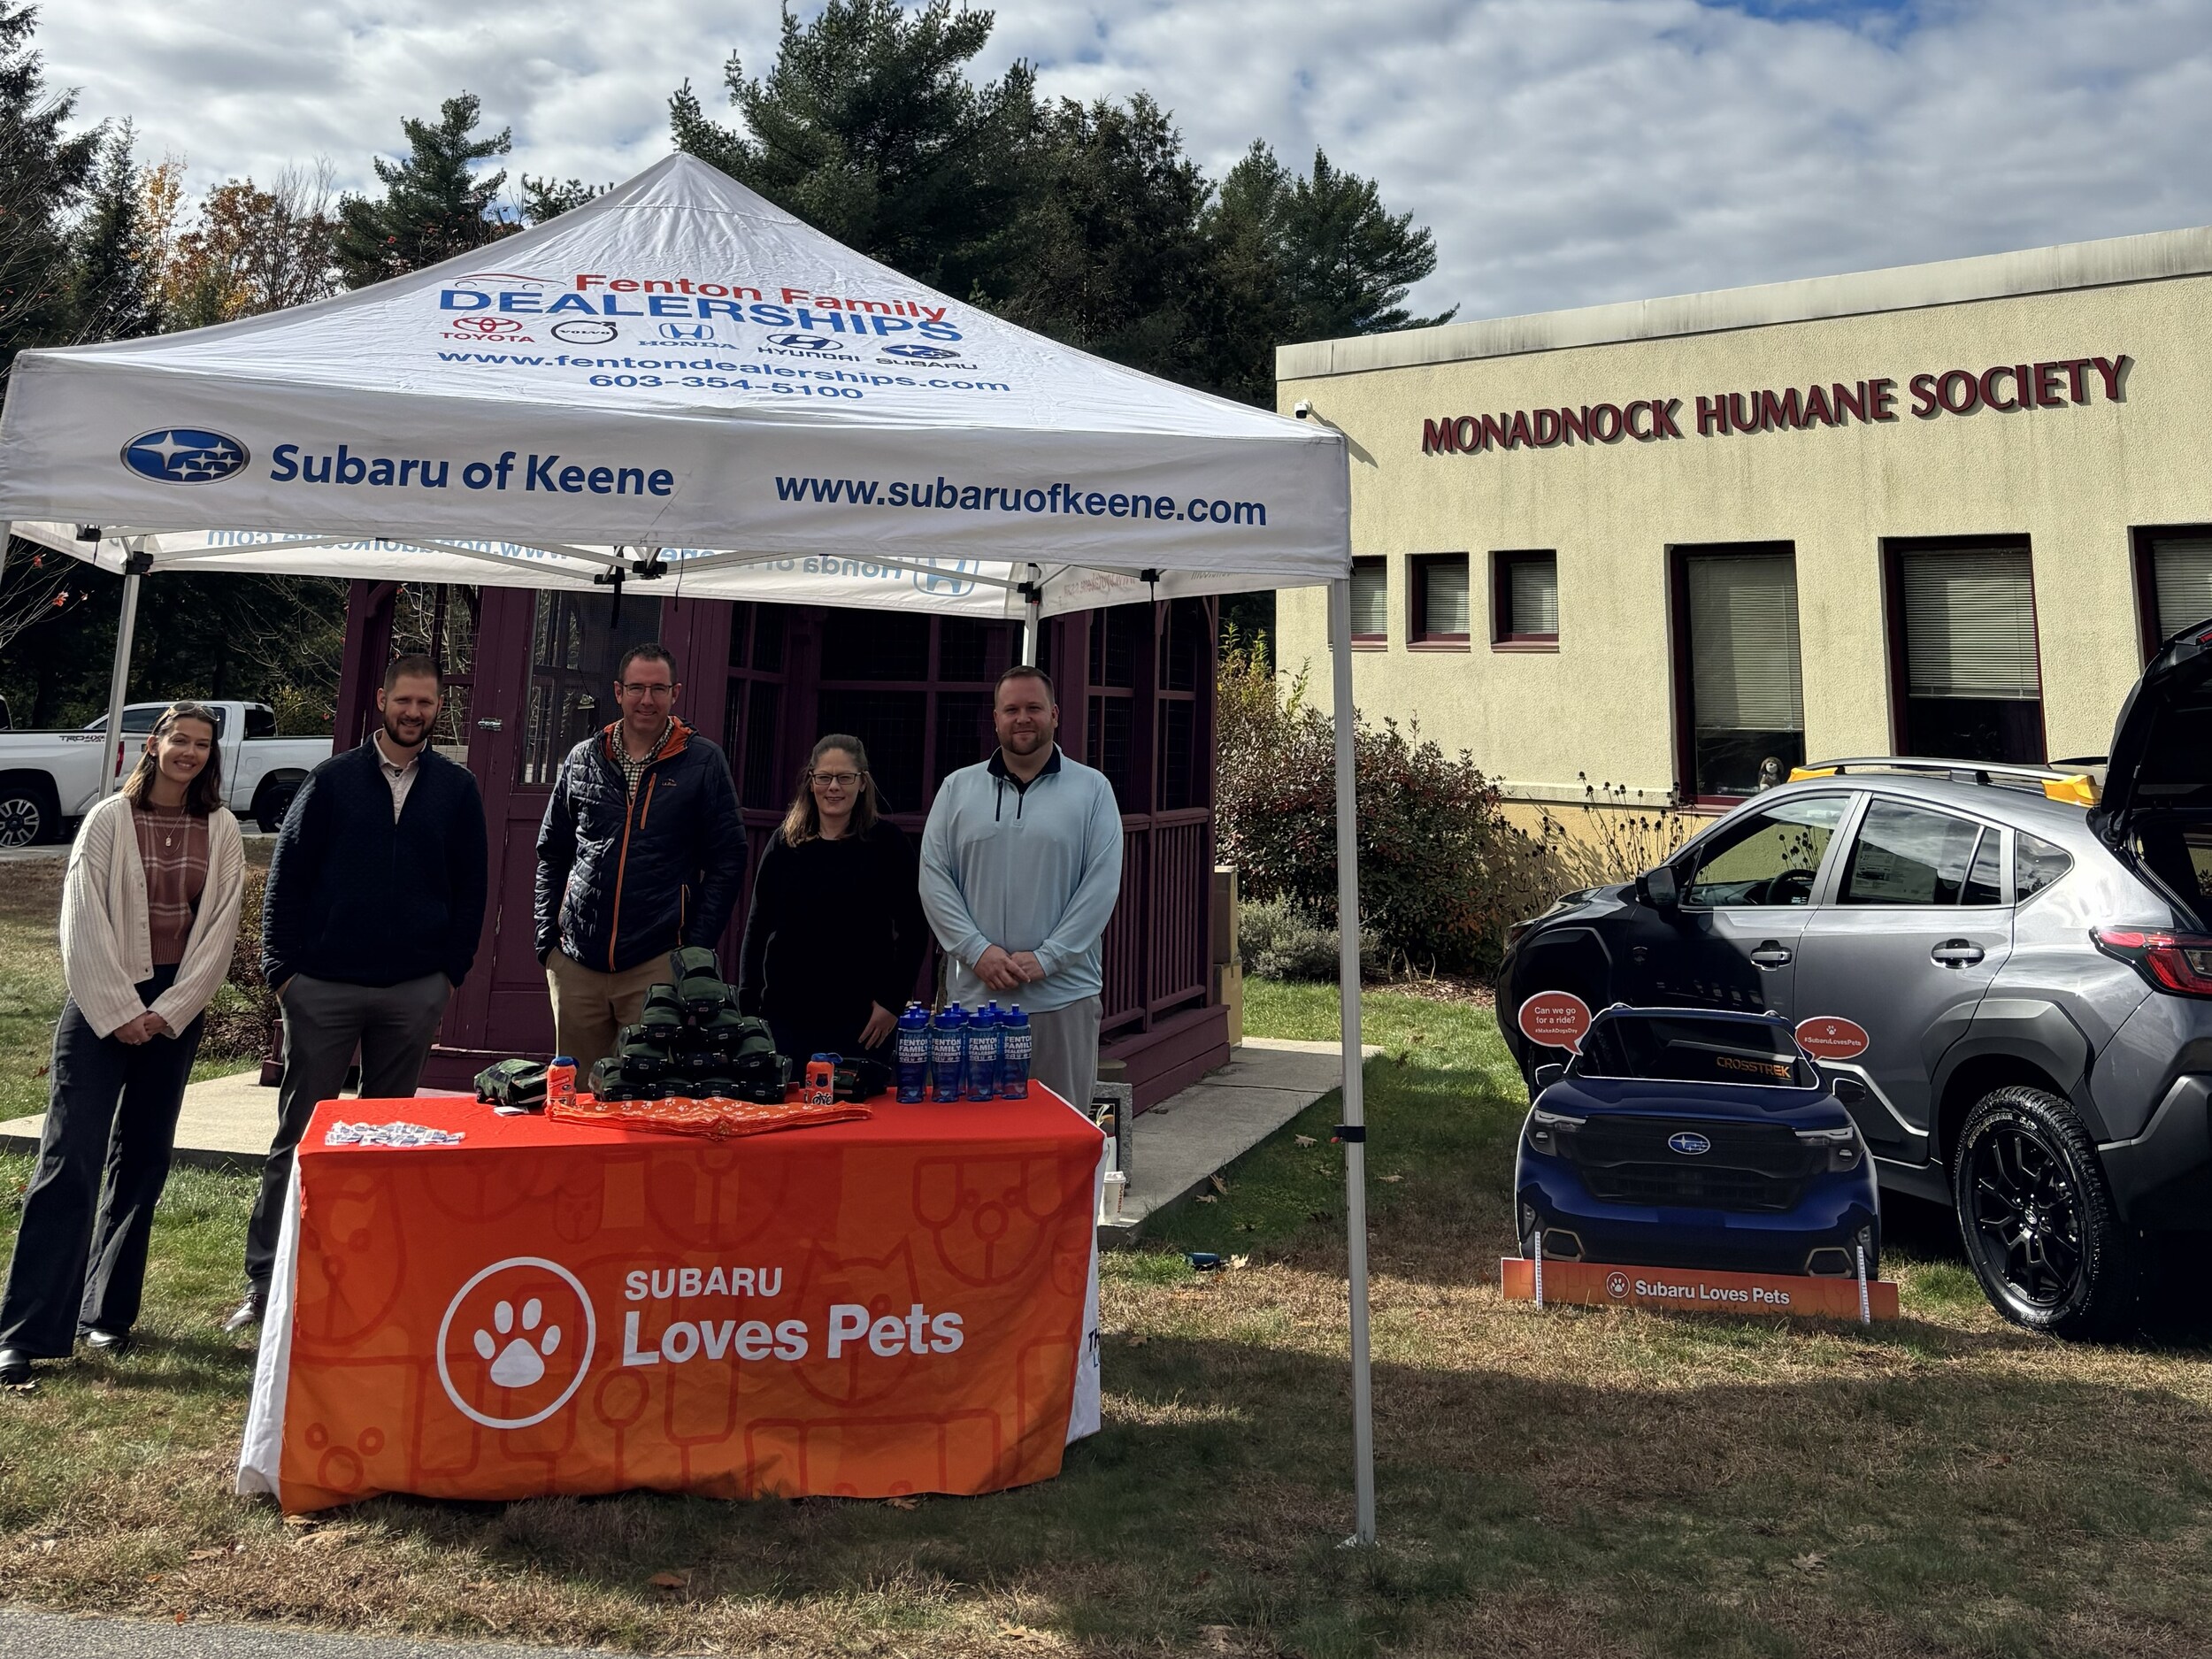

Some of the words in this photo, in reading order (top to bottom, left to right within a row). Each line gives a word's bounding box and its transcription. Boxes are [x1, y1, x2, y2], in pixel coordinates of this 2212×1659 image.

[576, 273, 763, 302] Fenton
[780, 287, 947, 323] Family
[439, 288, 964, 342] DEALERSHIPS
[439, 332, 535, 343] TOYOTA
[637, 340, 740, 350] HONDA
[757, 346, 860, 362] HYUNDAI
[875, 357, 978, 370] SUBARU
[436, 352, 1011, 392] www.fentondealerships.com
[588, 374, 864, 399] 603-354-5100
[1421, 398, 1684, 454] MONADNOCK
[1695, 377, 1895, 434] HUMANE
[1909, 354, 2127, 416] SOCIETY
[270, 443, 449, 488] Subaru
[463, 450, 514, 491] of
[525, 454, 674, 496] Keene
[775, 475, 1267, 526] www.subaruofkeene.com
[1534, 1006, 1550, 1015] Can
[1804, 1036, 1862, 1047] #SubaruLovesPets
[1717, 1056, 1792, 1079] CROSSTREK
[624, 1267, 784, 1302] SUBARU
[1635, 1279, 1695, 1299] Subaru
[1700, 1284, 1748, 1302] Loves
[1752, 1286, 1791, 1304] Pets
[622, 1310, 810, 1368] Loves
[826, 1303, 964, 1360] Pets
